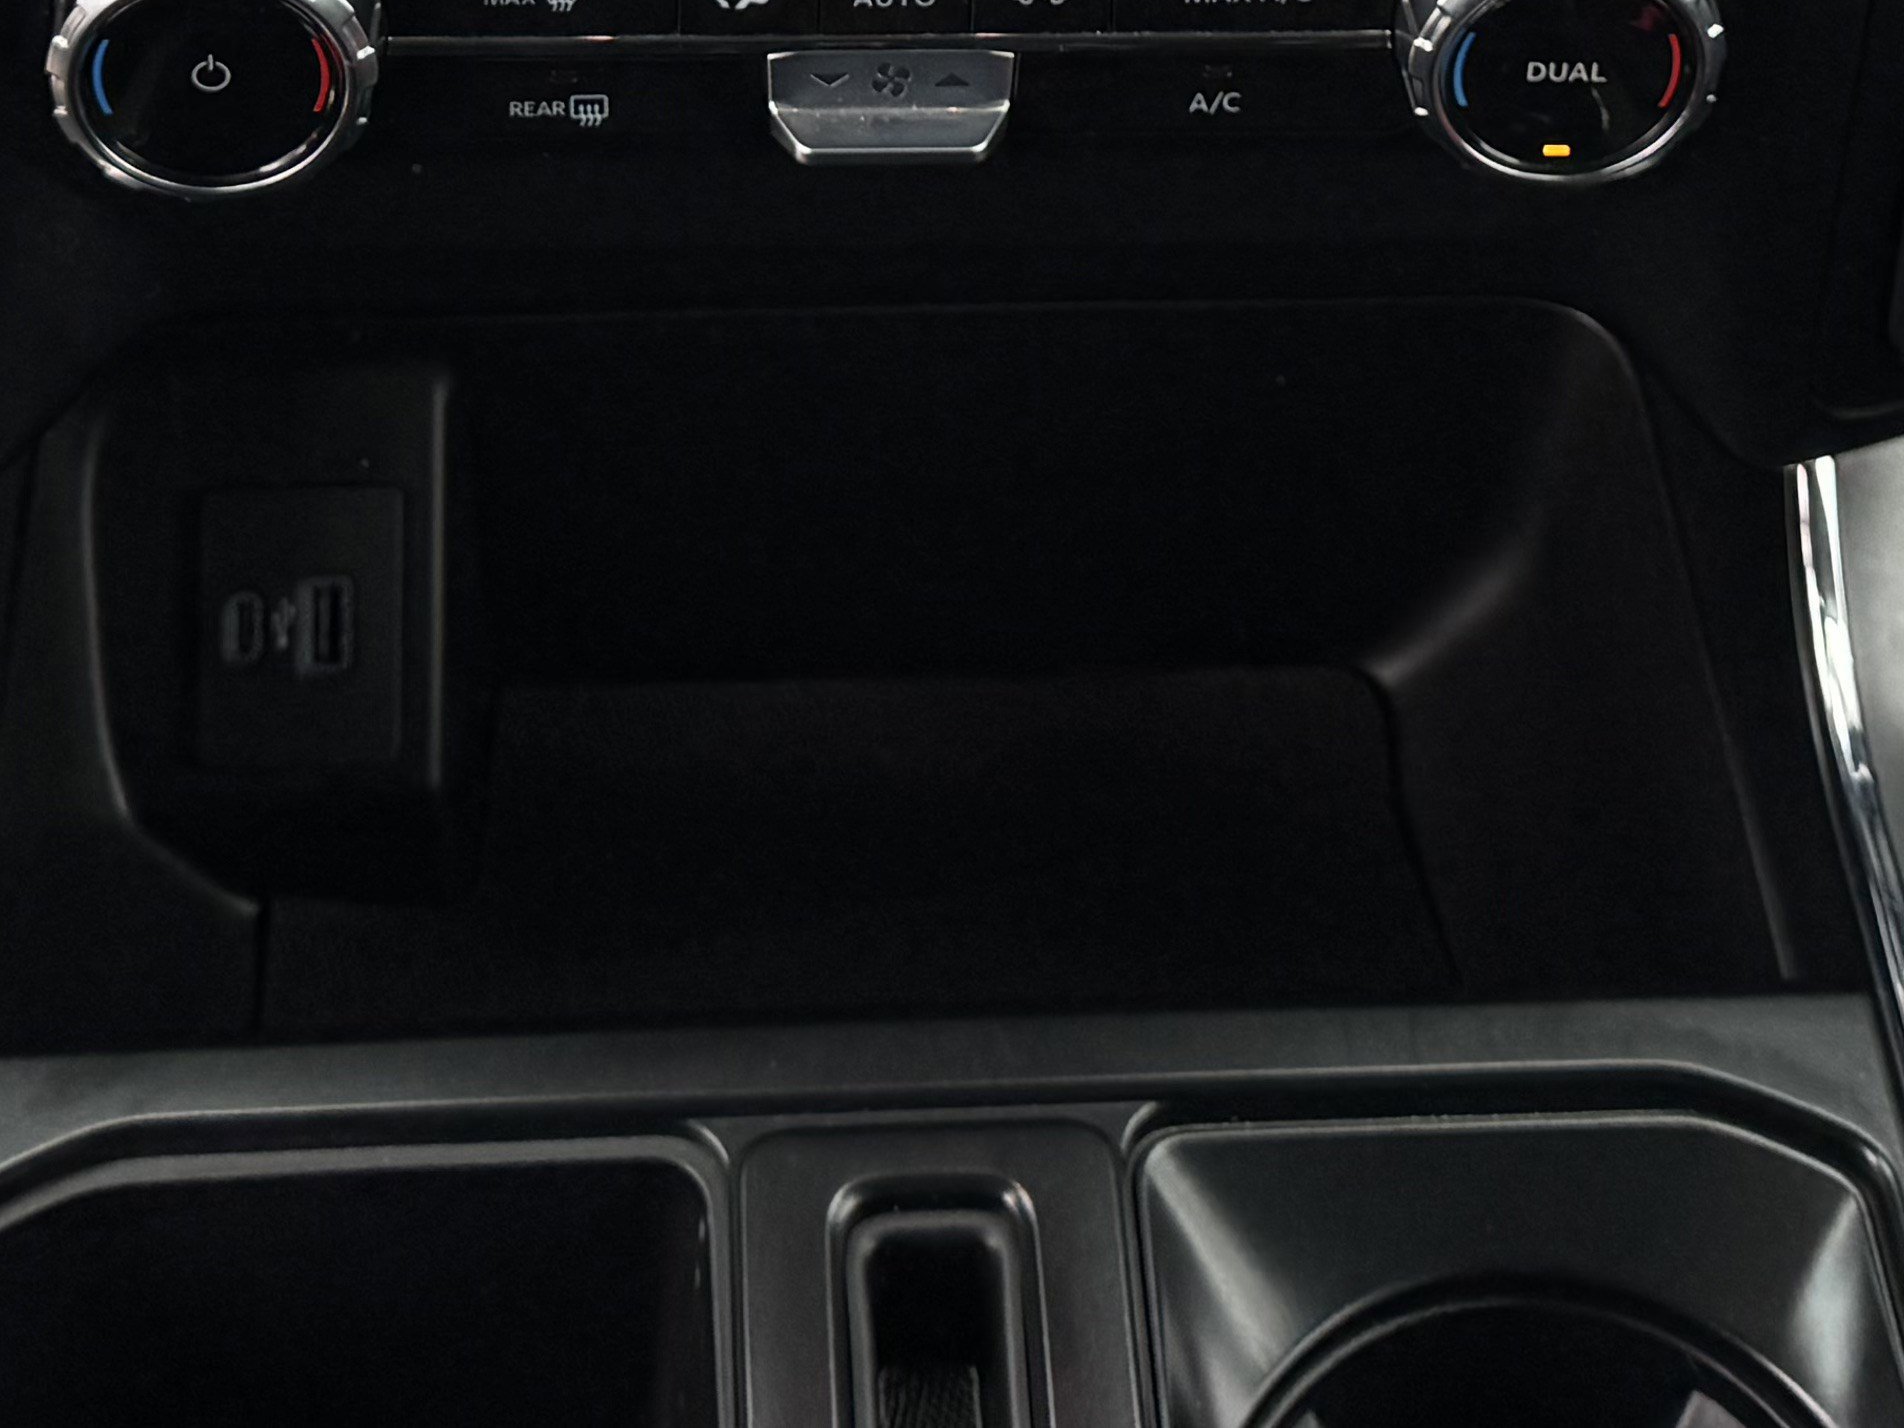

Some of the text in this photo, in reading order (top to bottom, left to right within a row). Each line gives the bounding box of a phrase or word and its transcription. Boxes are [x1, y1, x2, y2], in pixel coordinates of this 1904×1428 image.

[1525, 59, 1607, 86] DUAL
[508, 97, 569, 121] REAR
[1187, 88, 1242, 115] A/C
